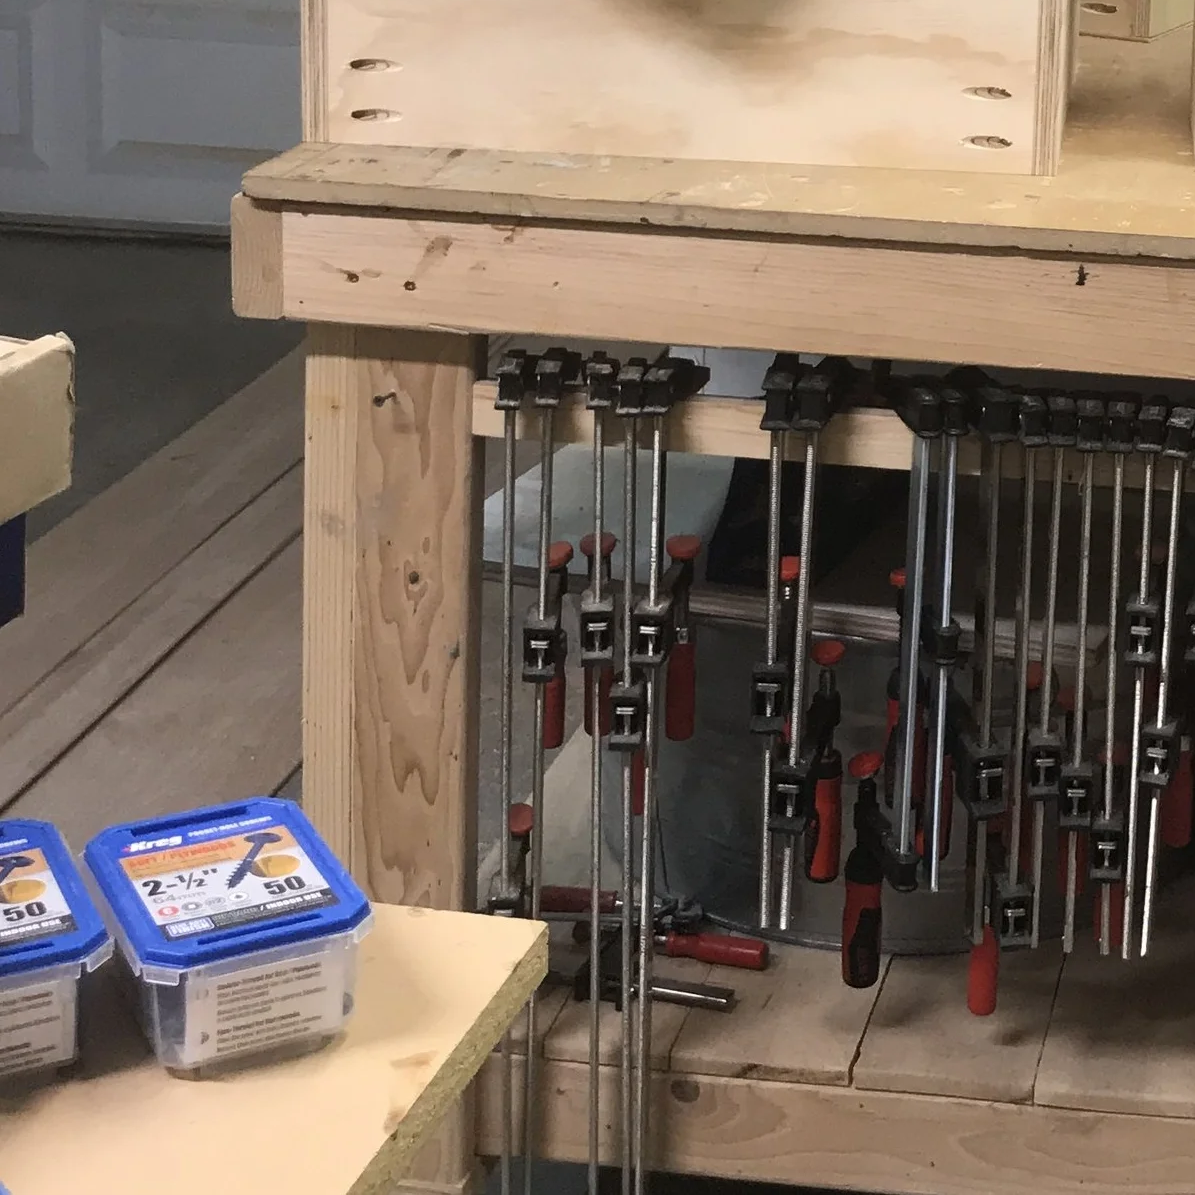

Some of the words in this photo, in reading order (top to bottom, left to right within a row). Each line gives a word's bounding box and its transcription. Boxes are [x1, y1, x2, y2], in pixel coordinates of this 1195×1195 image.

[130, 836, 182, 852] Kreg
[263, 875, 306, 895] 50
[3, 901, 47, 922] 50
